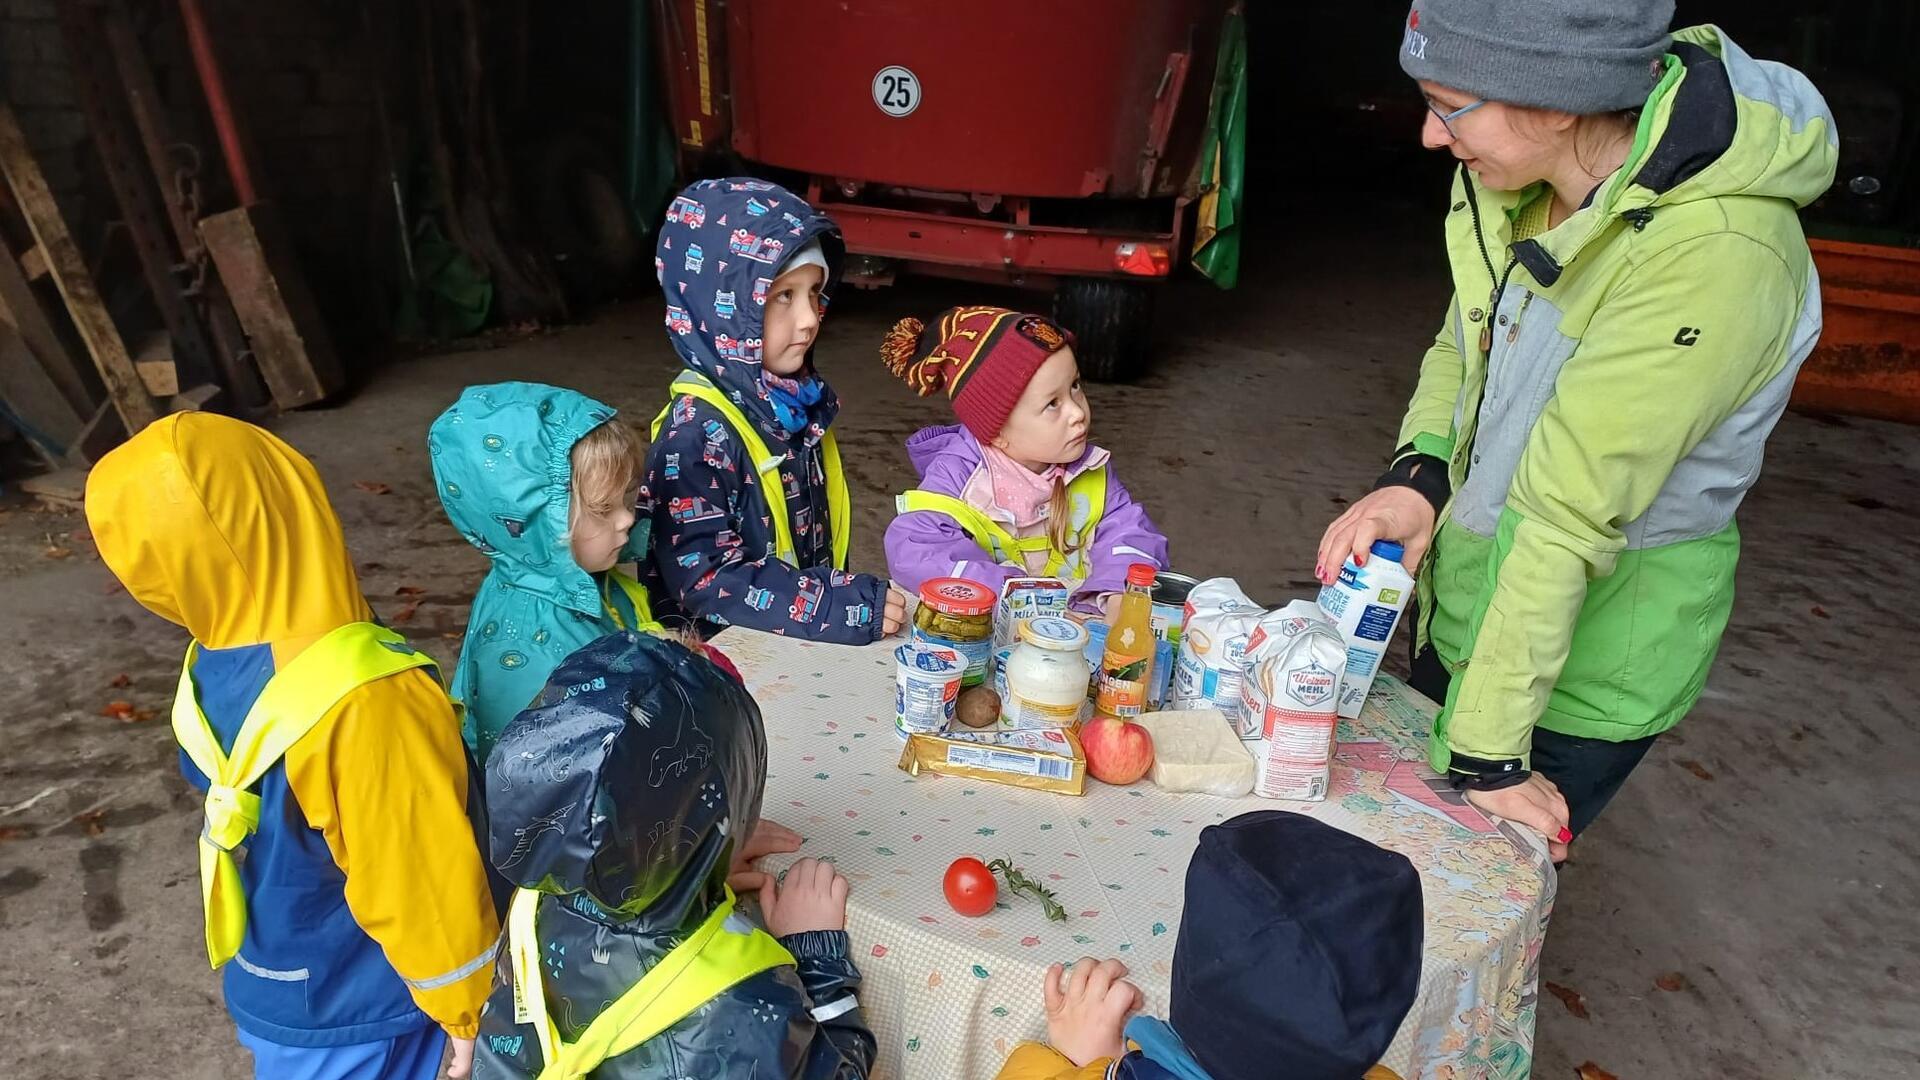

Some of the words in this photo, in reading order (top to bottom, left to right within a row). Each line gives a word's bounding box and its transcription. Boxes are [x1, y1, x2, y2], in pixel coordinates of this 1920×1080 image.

[881, 75, 910, 108] 25
[1292, 673, 1331, 686] Weizen
[1297, 685, 1325, 694] MEHL
